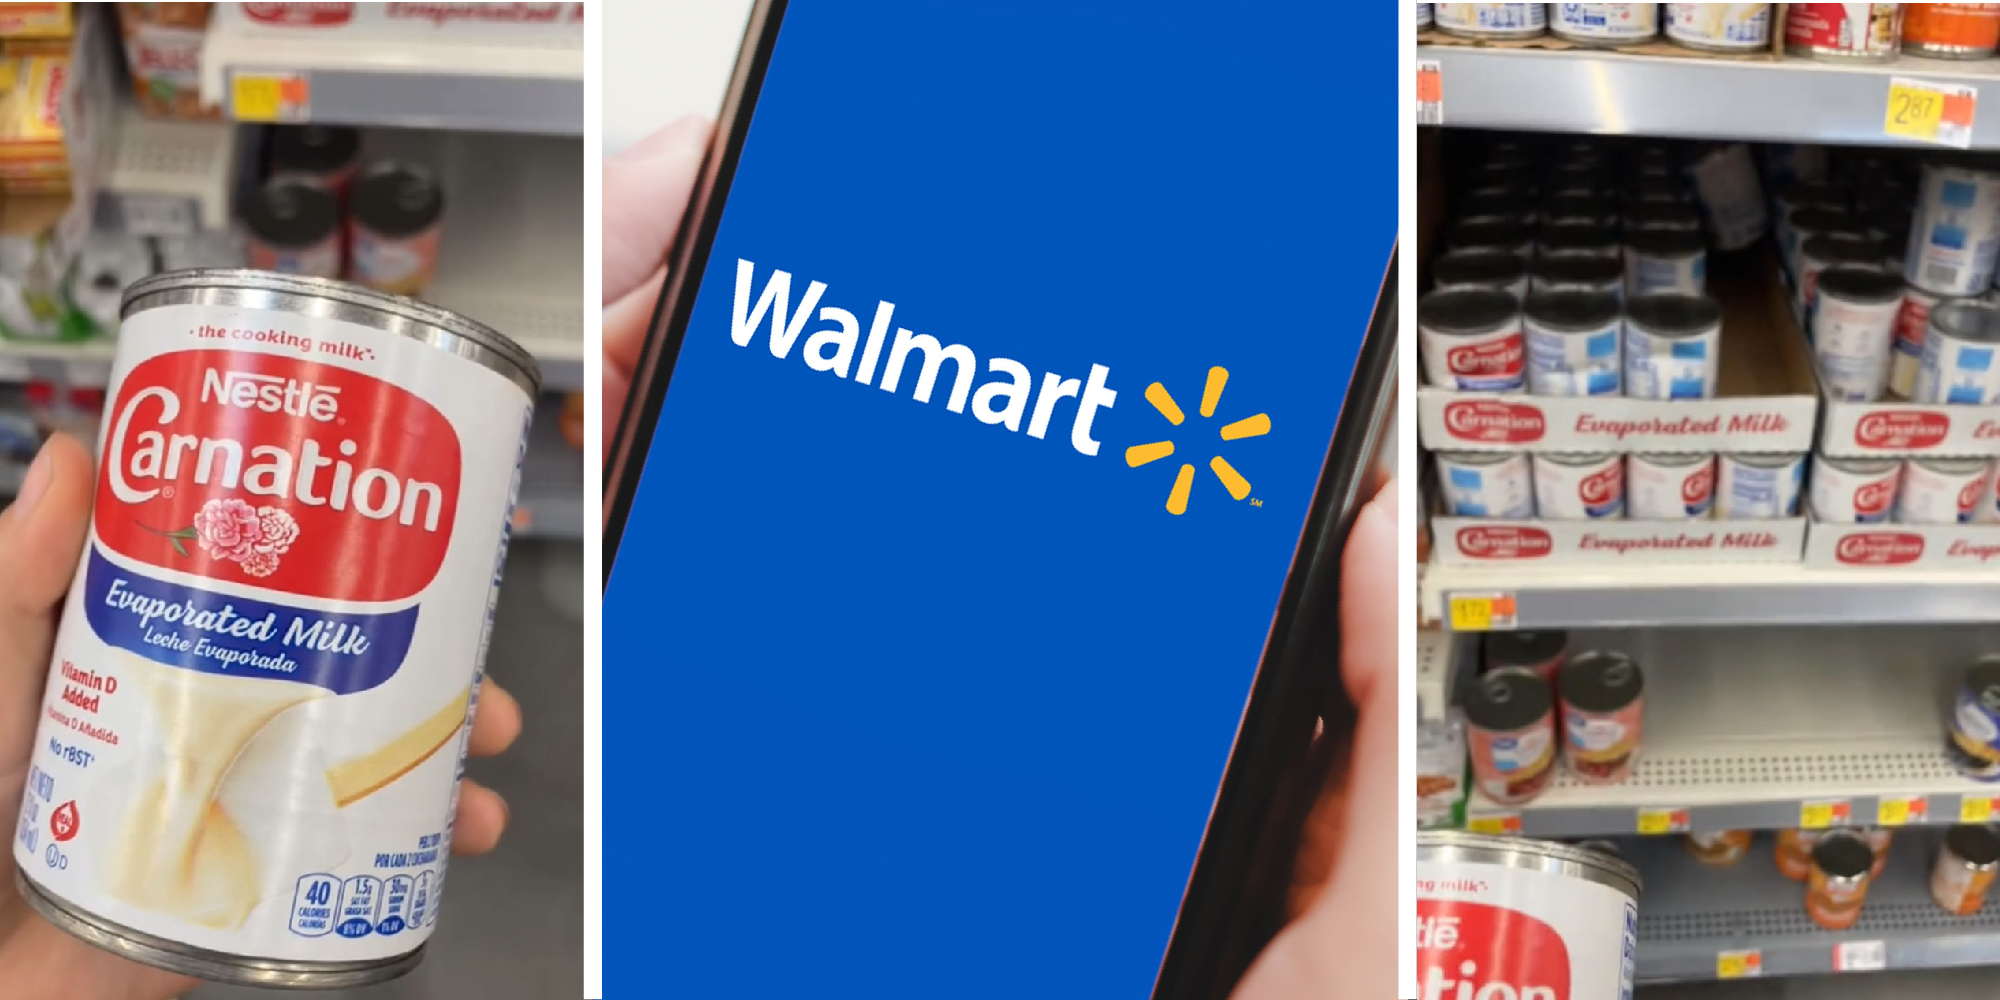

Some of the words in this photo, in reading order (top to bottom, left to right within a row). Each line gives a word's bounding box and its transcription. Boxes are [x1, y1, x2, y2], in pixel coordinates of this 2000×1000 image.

[199, 325, 226, 338] the
[231, 330, 312, 352] cooking
[731, 258, 1117, 456] Walmart
[1575, 414, 1720, 440] Evaporated
[1726, 414, 1789, 435] Milk
[109, 386, 442, 531] Carnation
[105, 578, 276, 642] Evaporated
[282, 616, 370, 656] Milk
[143, 626, 191, 652] Leche
[194, 639, 298, 674] Evaporada
[61, 660, 102, 691] Vitamin
[105, 676, 118, 694] D
[61, 684, 100, 714] Added
[49, 736, 62, 755] No
[305, 880, 331, 905] 40
